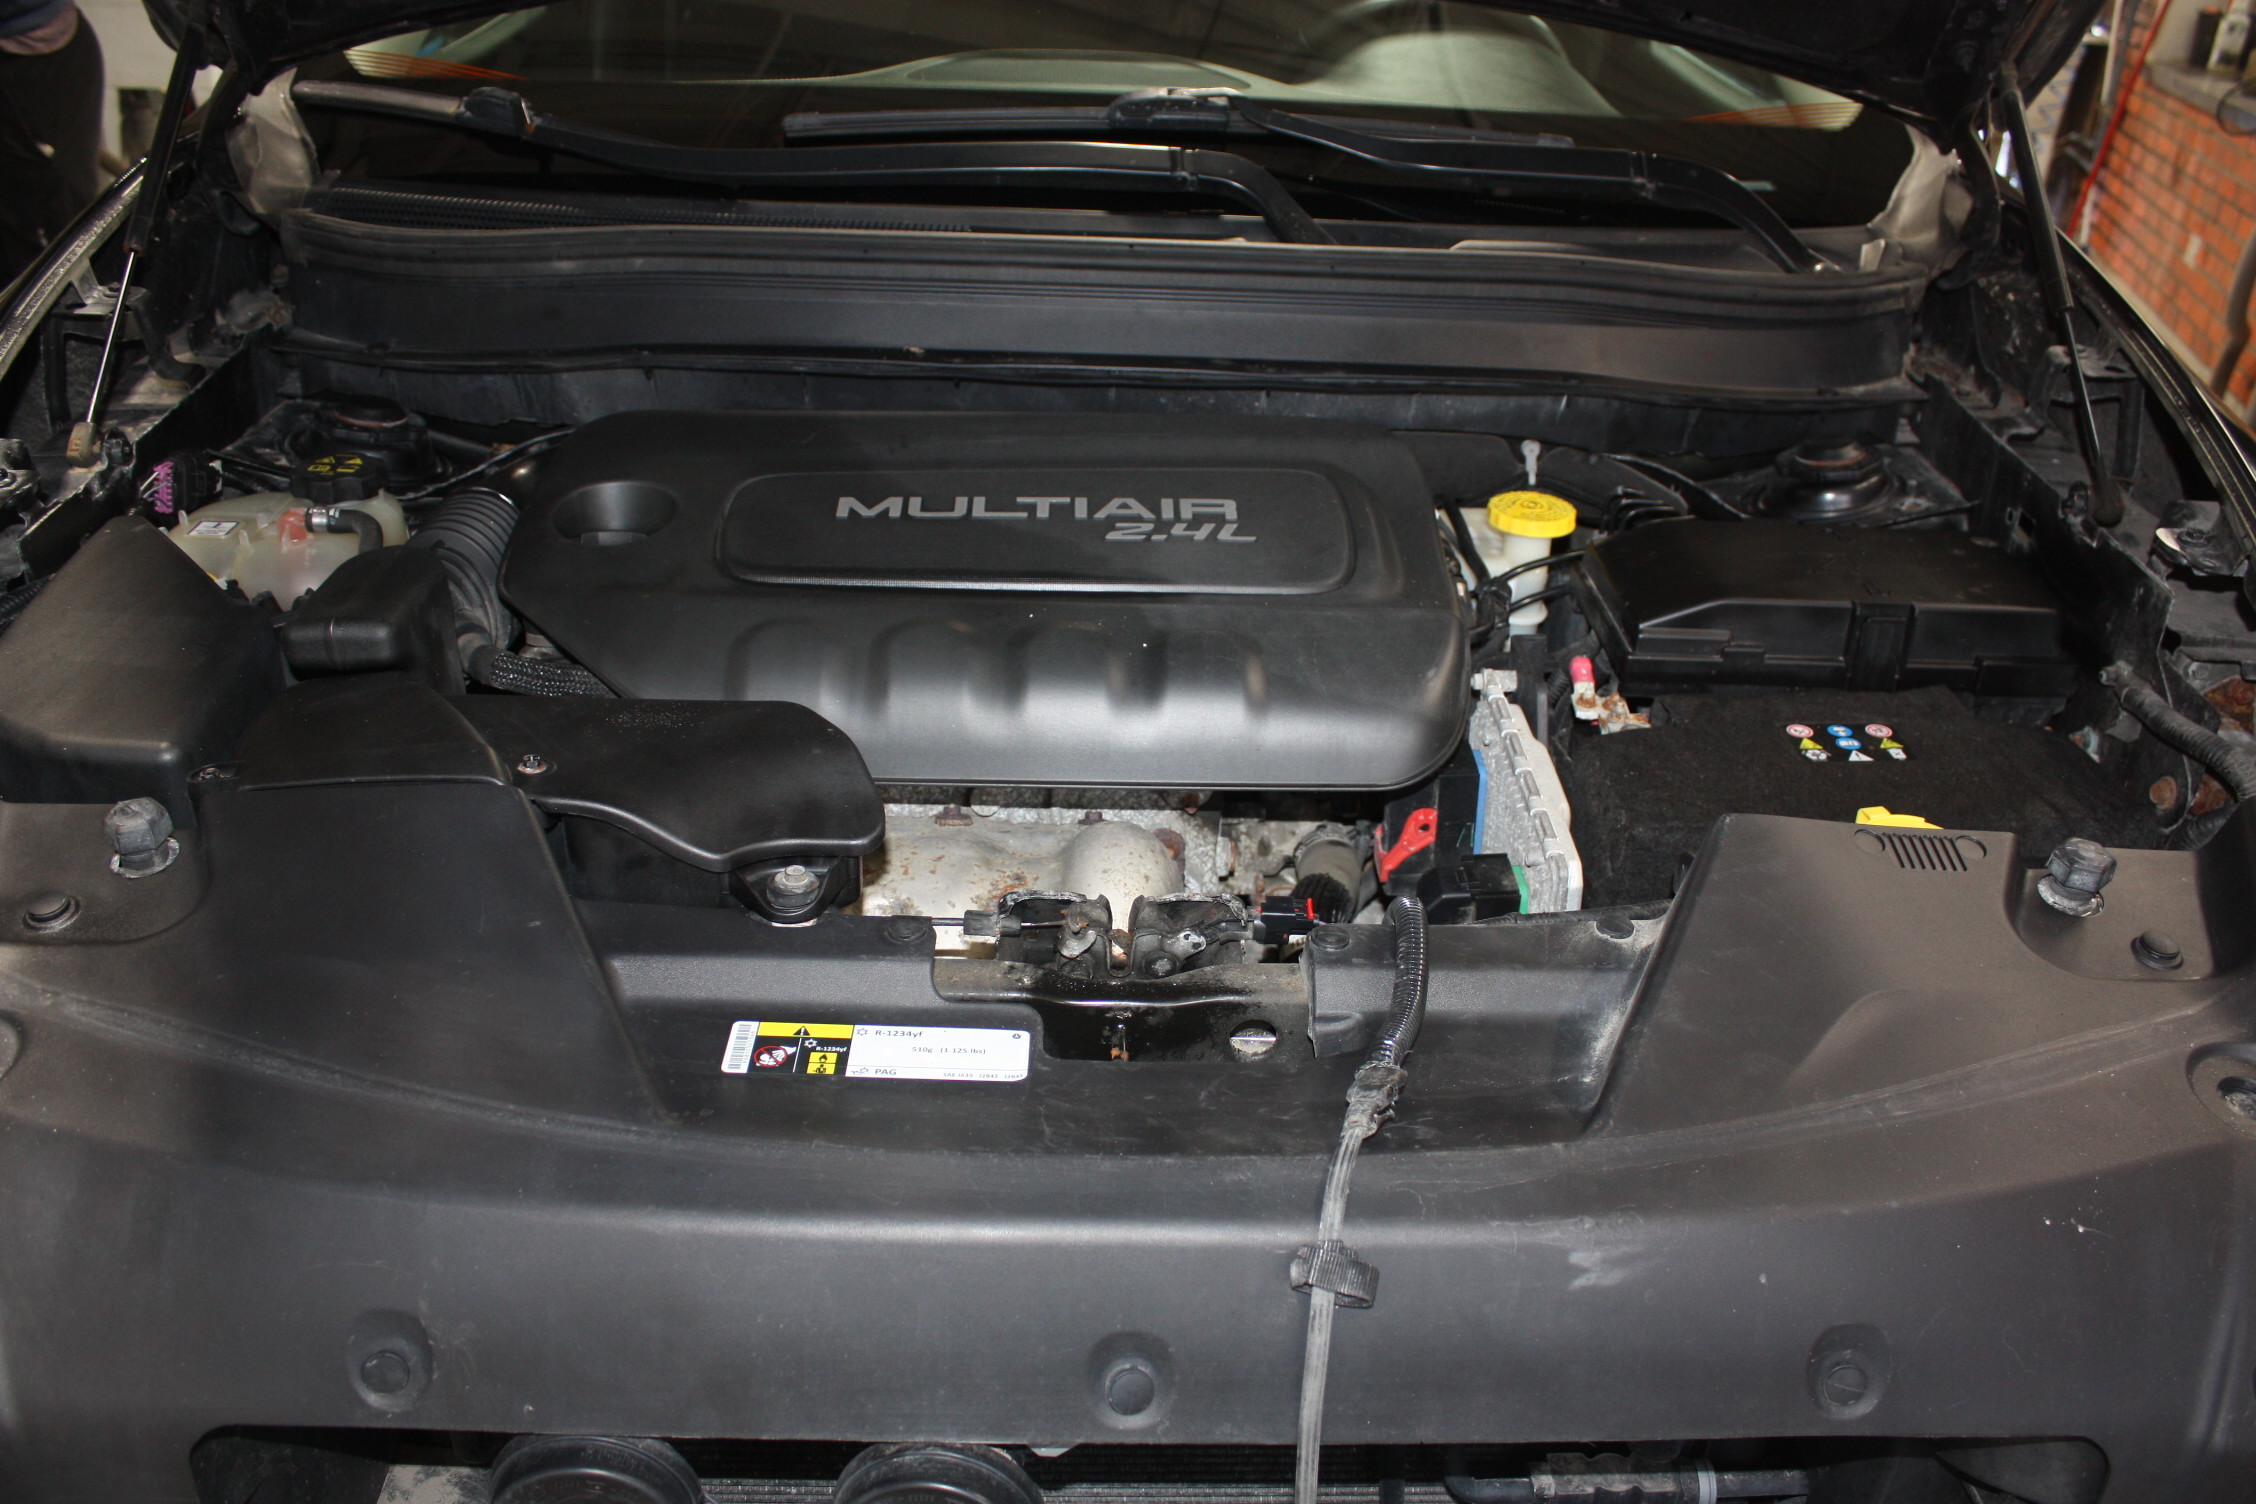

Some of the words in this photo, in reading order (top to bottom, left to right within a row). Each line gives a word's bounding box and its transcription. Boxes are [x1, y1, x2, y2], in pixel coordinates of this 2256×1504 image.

[835, 496, 1238, 520] MULTIAIR
[1105, 522, 1258, 543] 2.4L
[874, 1029, 924, 1039] R-1234yf
[874, 1068, 897, 1076] PAG
